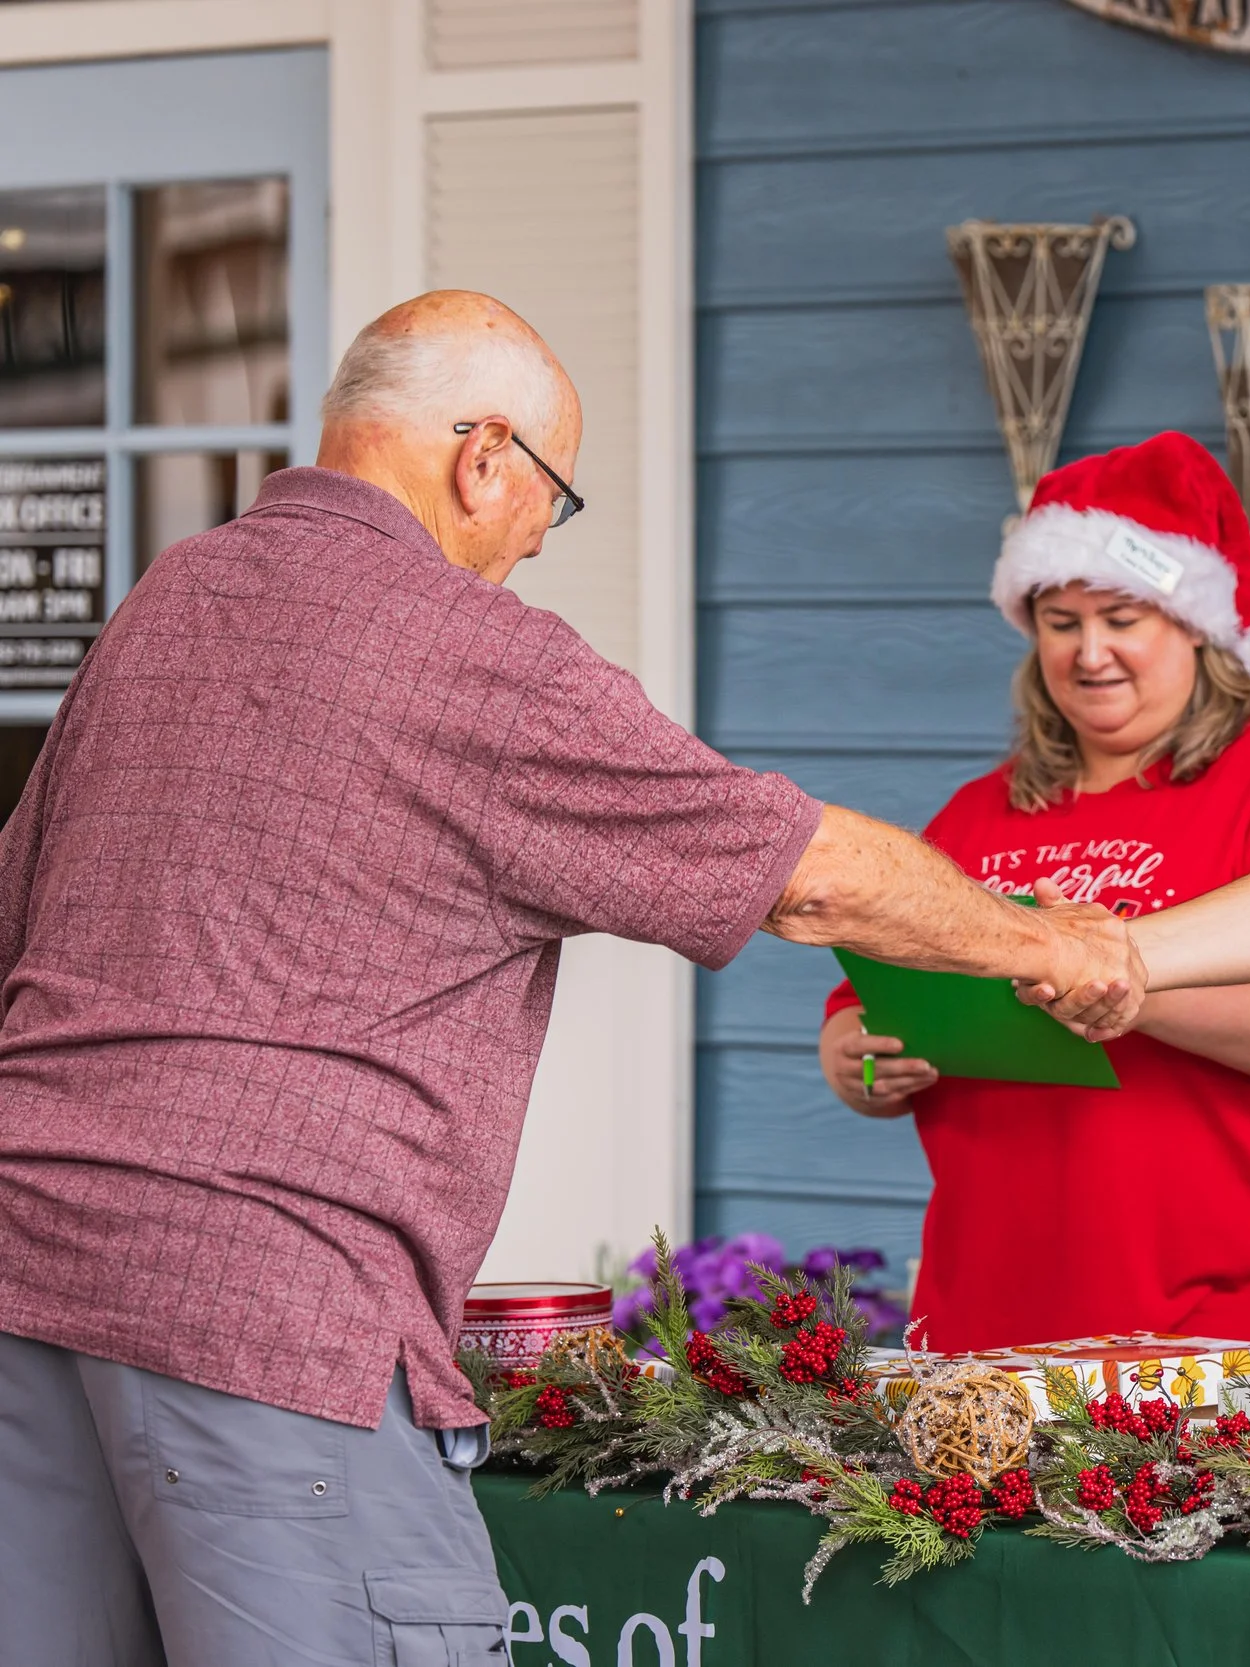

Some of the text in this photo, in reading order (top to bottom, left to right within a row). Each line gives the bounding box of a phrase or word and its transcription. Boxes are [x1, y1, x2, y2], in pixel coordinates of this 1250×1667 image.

[981, 839, 1153, 875] IT'S THE MOST
[617, 1556, 726, 1667] of
